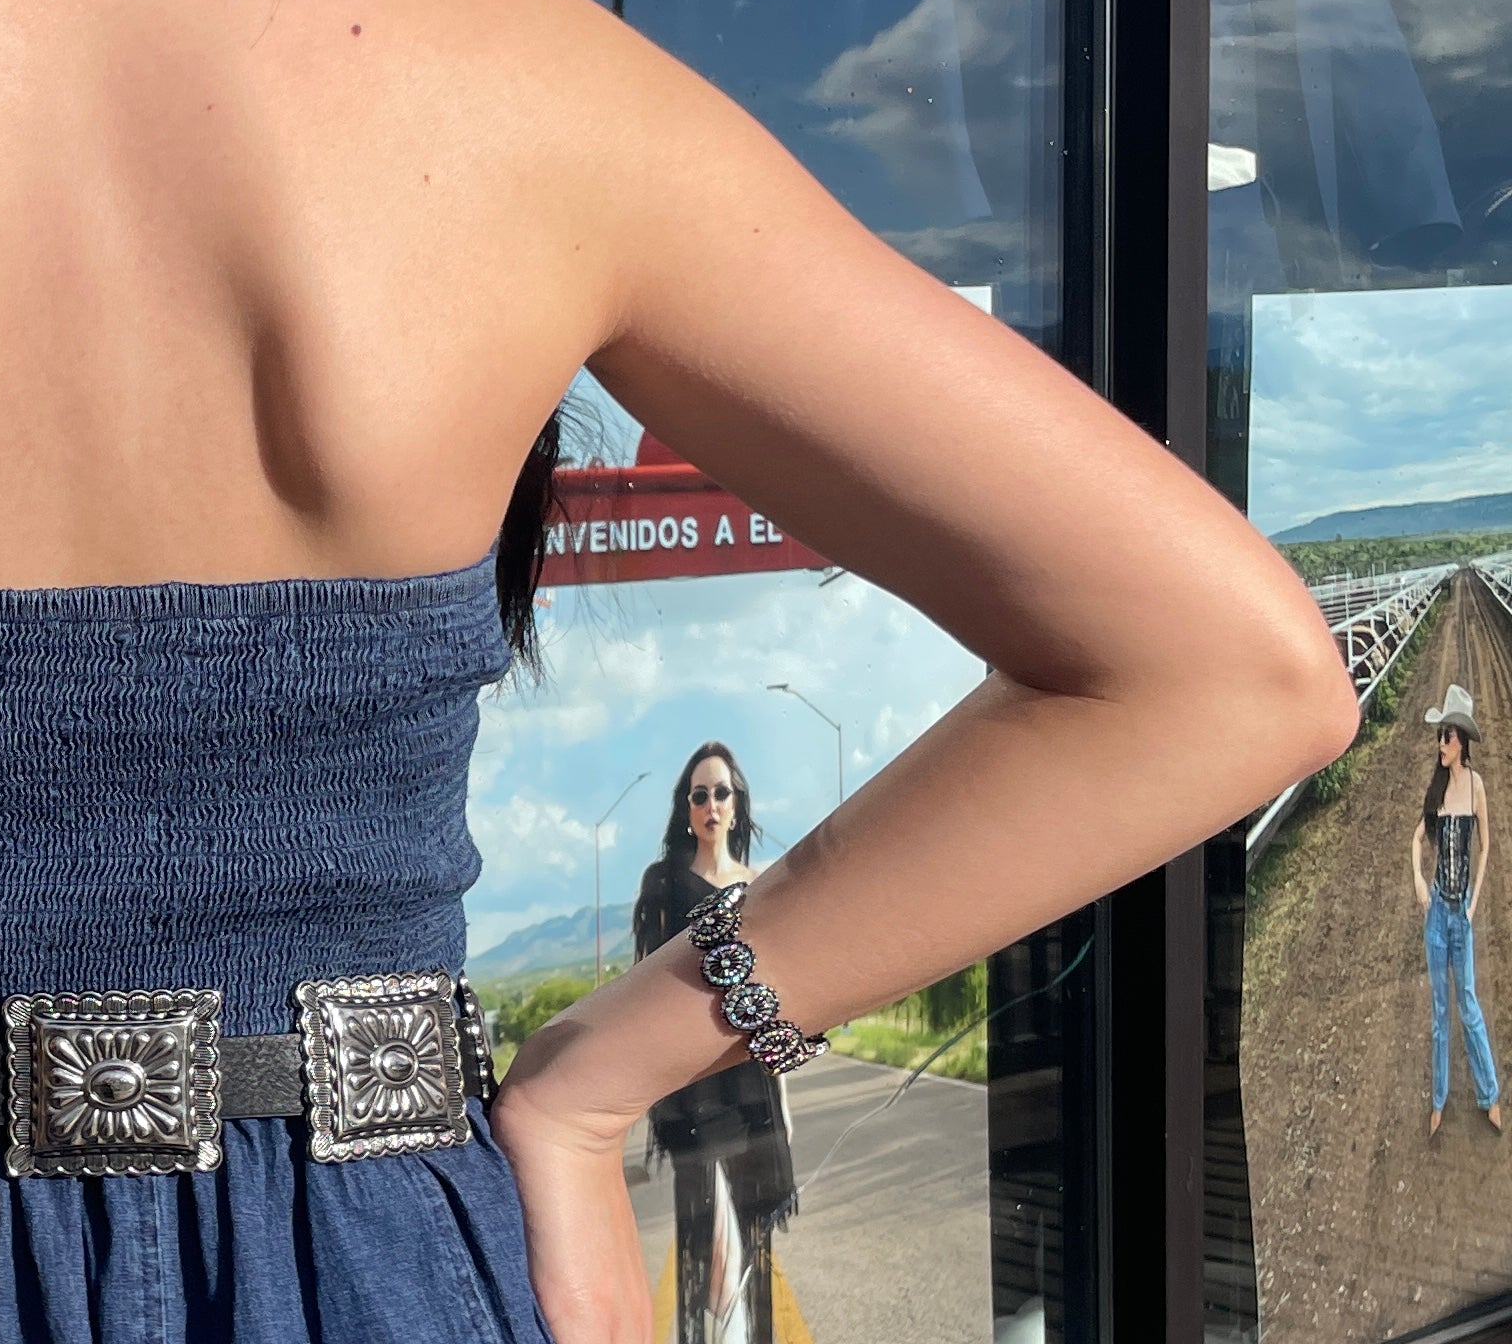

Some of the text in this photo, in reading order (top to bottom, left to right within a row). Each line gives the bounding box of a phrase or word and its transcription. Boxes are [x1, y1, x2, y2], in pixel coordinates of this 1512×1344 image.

[534, 512, 783, 555] NVENIDOS A EL
